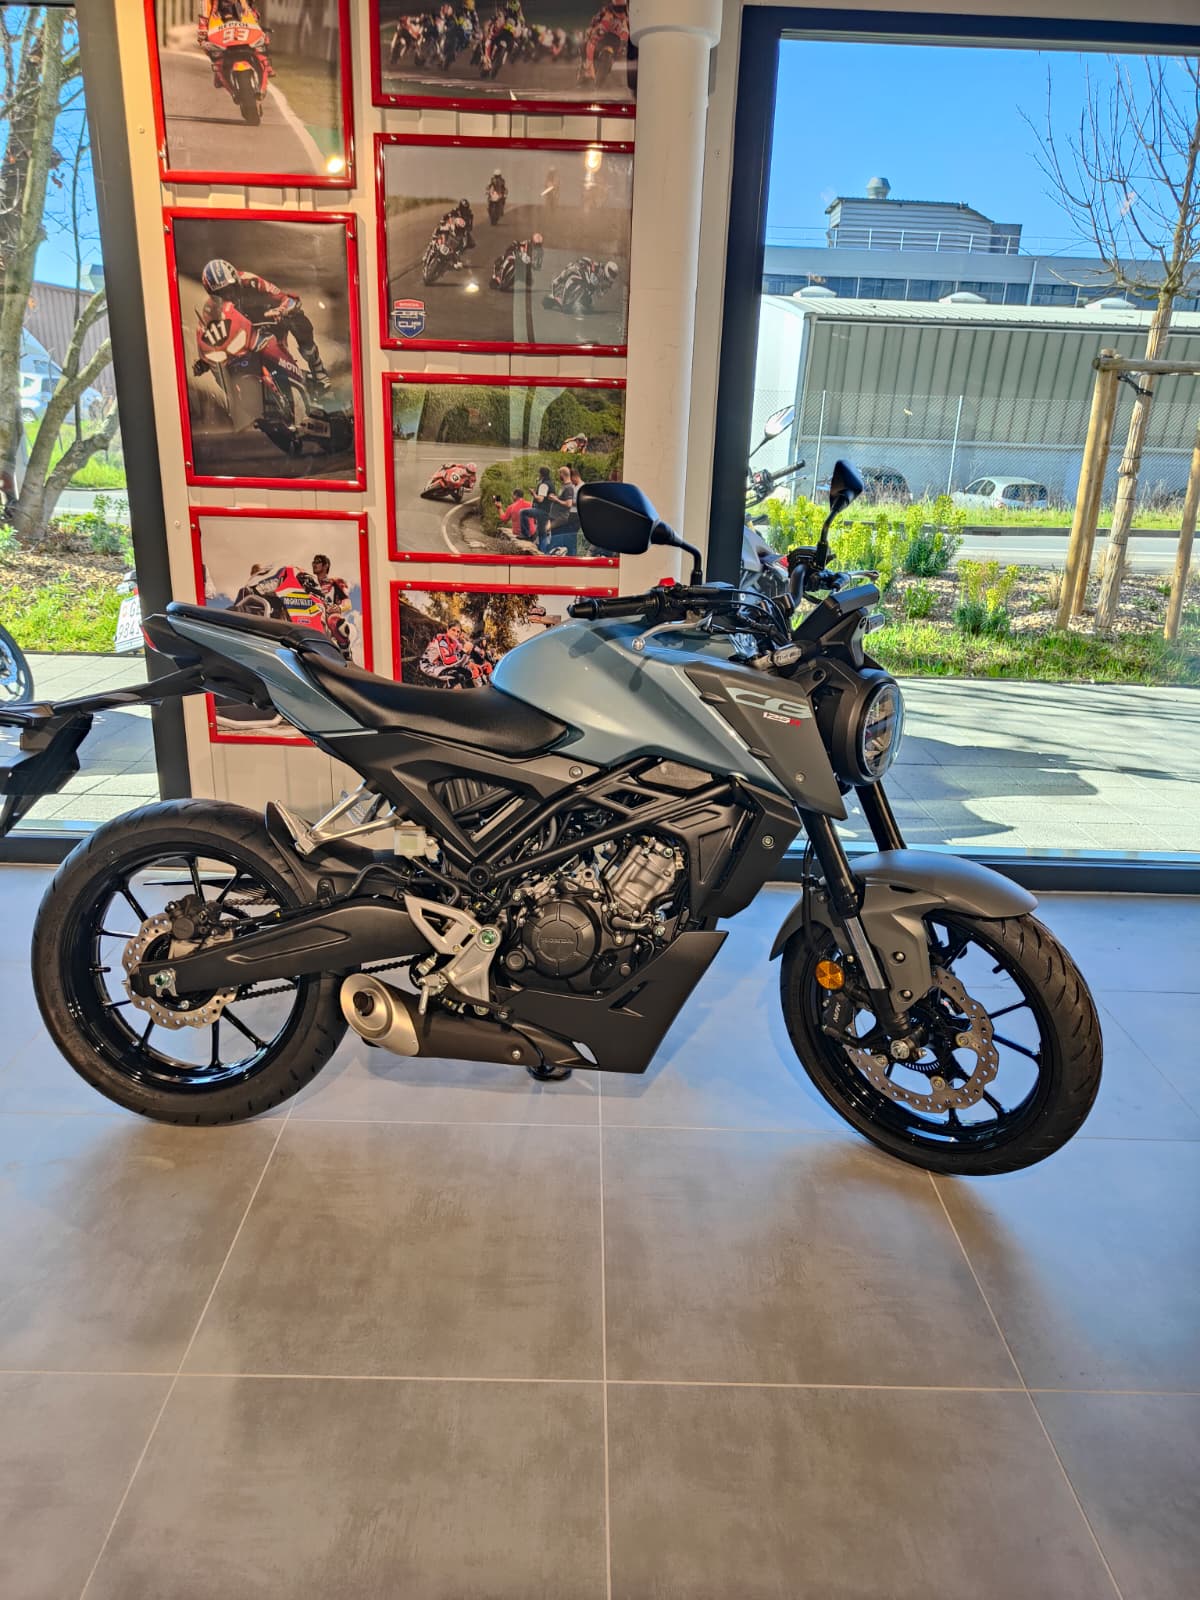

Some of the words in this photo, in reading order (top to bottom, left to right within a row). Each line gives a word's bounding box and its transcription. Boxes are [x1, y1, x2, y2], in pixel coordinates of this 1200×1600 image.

[222, 28, 250, 44] 93
[204, 320, 228, 346] 111
[726, 687, 813, 719] CB
[540, 936, 574, 945] HONDA
